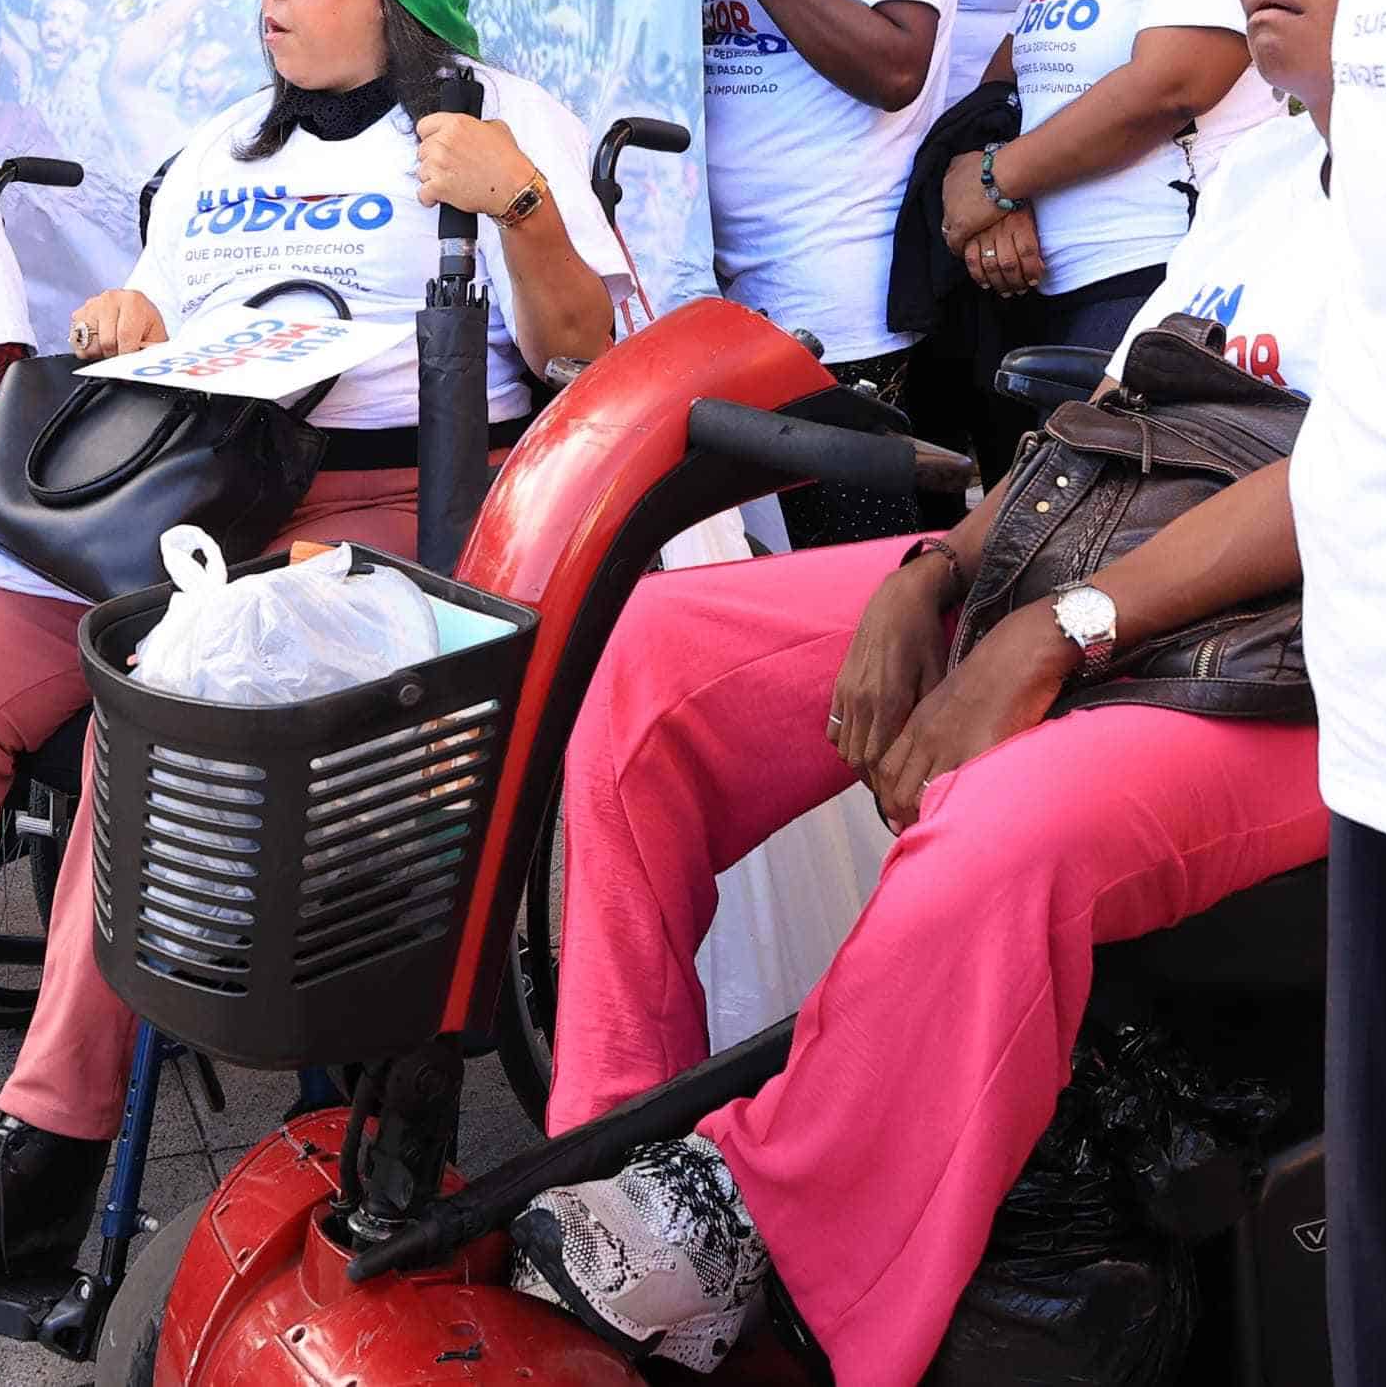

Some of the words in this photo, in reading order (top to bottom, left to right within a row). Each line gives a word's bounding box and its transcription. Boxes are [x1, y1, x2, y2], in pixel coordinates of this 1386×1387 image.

[717, 65, 763, 75] PASADO
[714, 83, 778, 94] IMPUNIDAD
[185, 248, 211, 262] QUE
[213, 245, 281, 260] PROTEJA
[285, 243, 366, 256] DERECHOS
